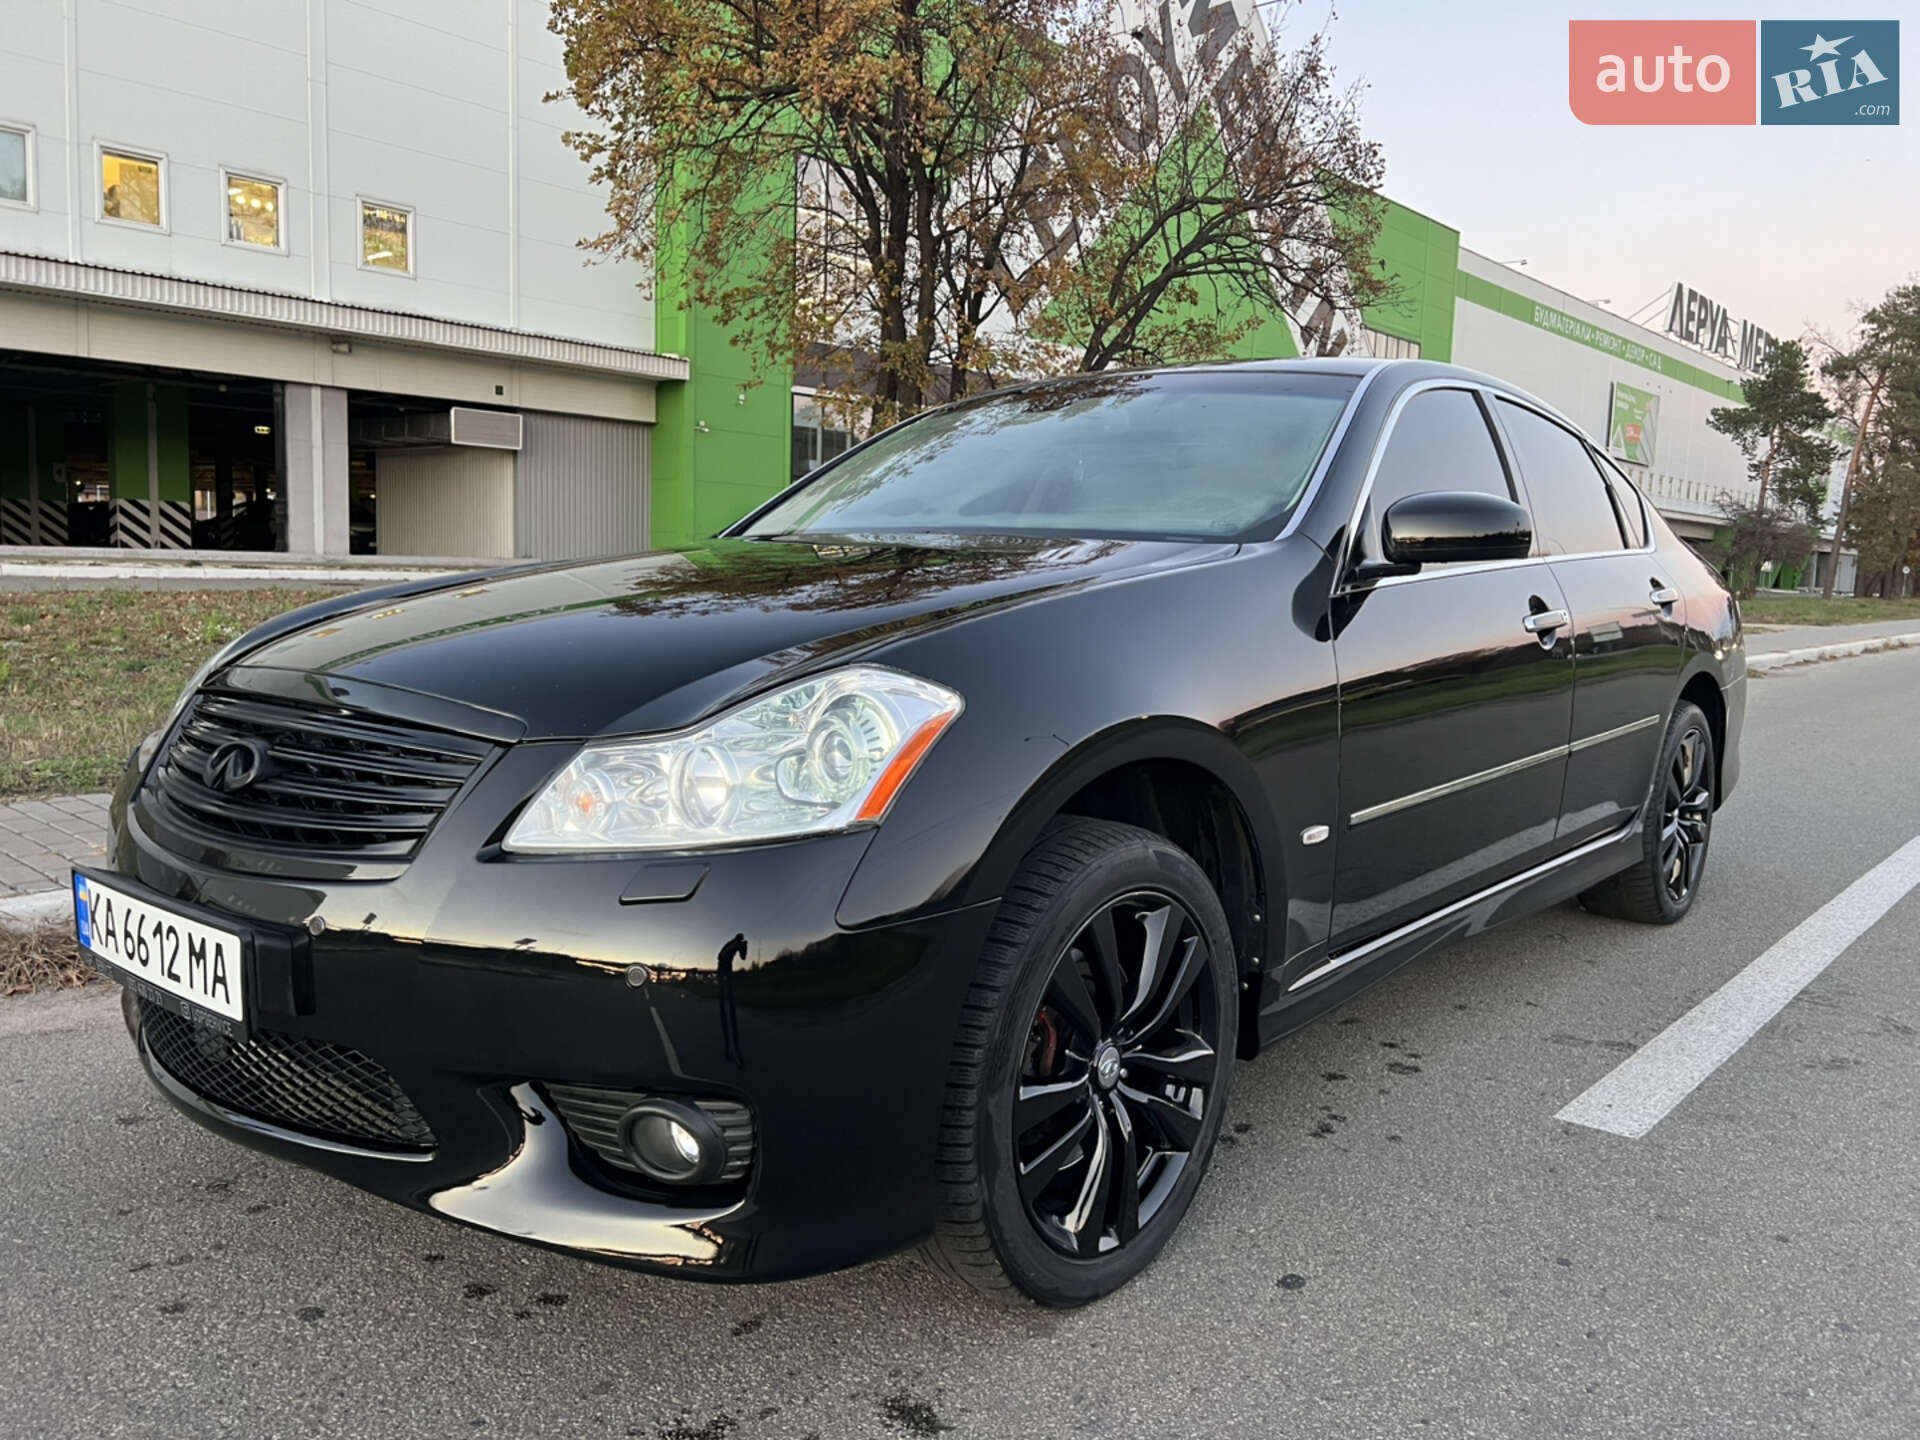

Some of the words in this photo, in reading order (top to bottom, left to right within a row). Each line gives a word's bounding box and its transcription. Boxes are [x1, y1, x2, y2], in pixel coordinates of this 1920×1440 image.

[1666, 281, 1728, 358] ЛЕРУА
[88, 888, 119, 954] KA
[124, 908, 181, 984] 6612
[187, 931, 230, 1005] MA
